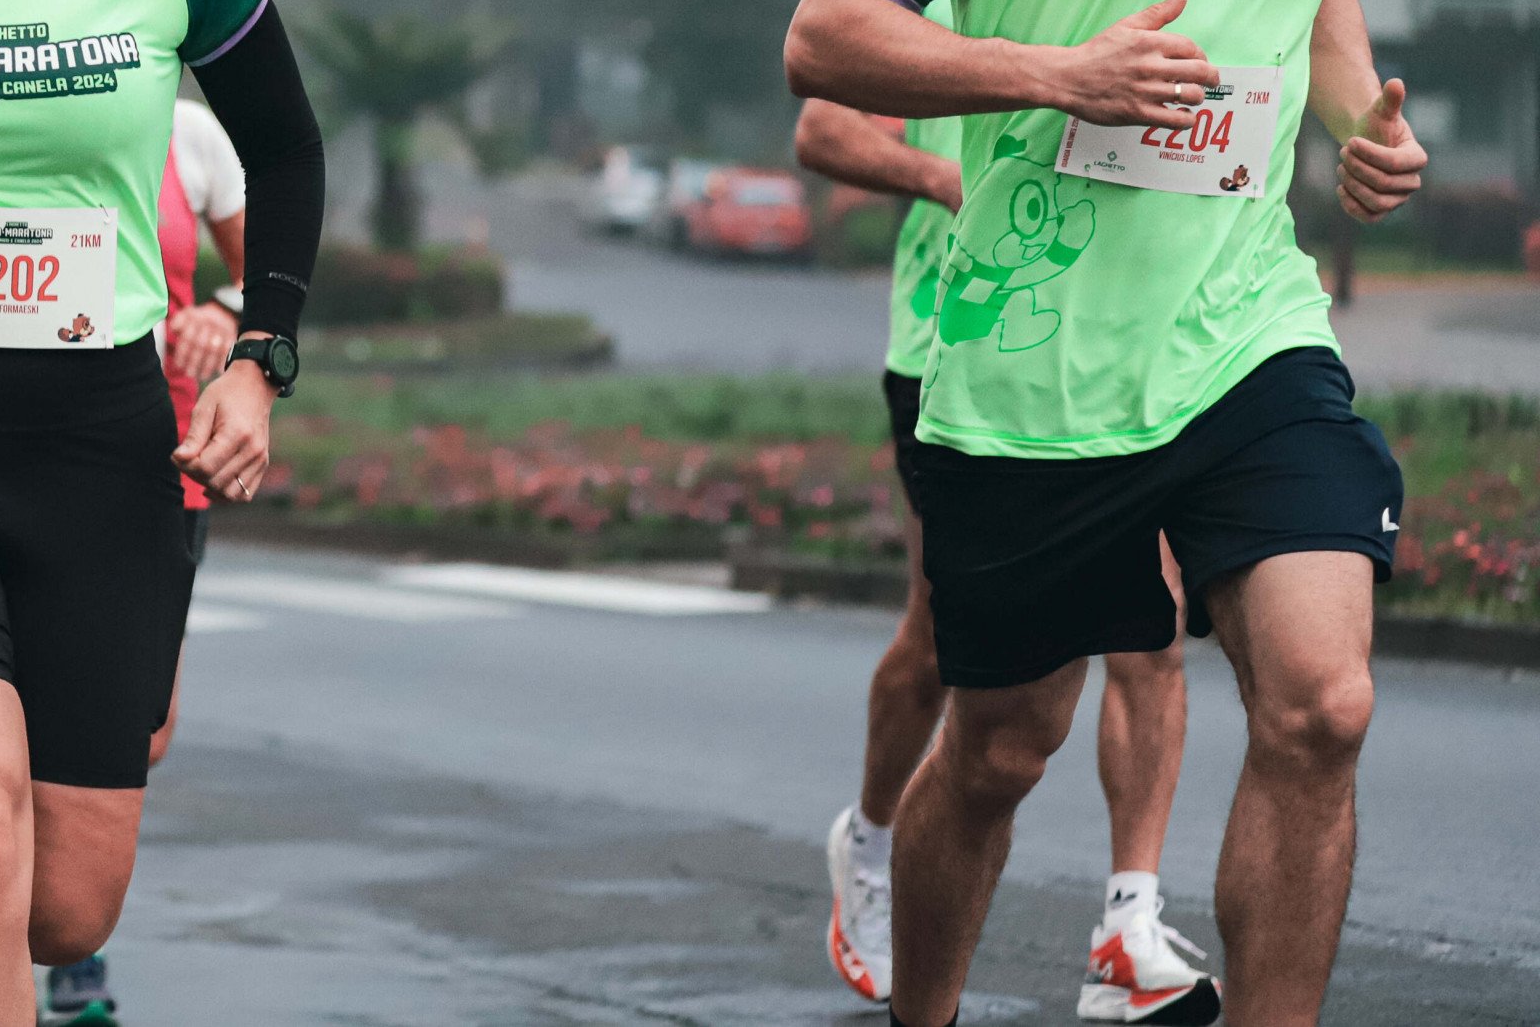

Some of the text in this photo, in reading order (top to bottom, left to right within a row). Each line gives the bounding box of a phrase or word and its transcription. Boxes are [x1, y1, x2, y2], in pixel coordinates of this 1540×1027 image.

[2, 77, 68, 95] CANELA
[72, 72, 115, 90] 2024
[1185, 154, 1206, 164] LOPES
[70, 233, 102, 249] 21KM
